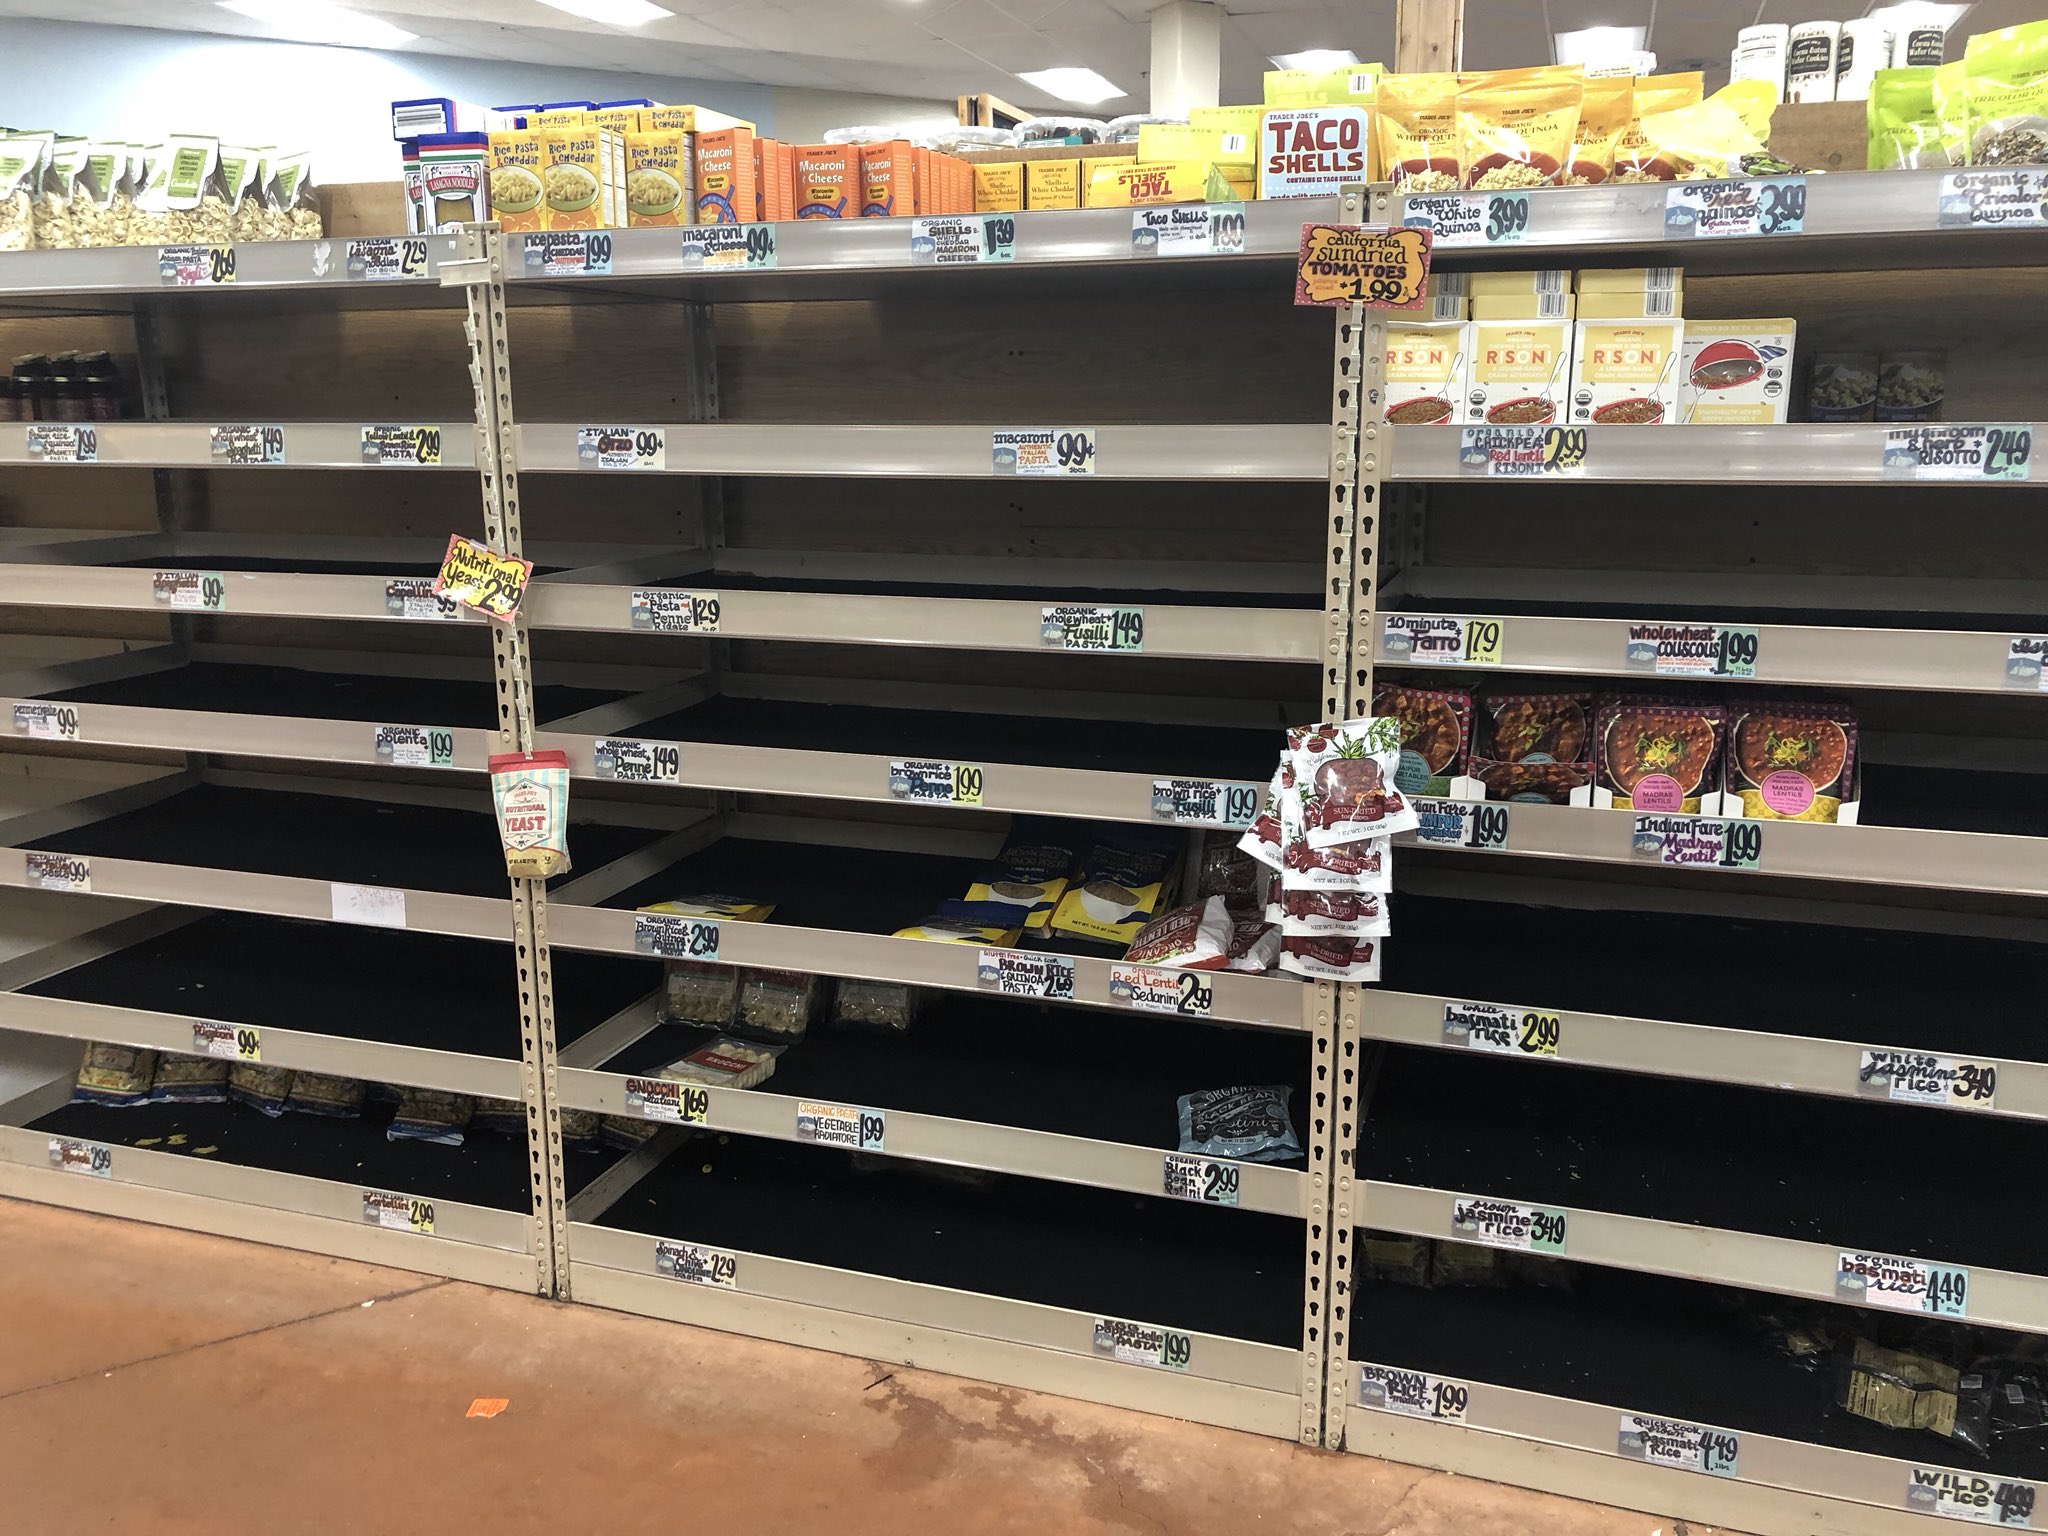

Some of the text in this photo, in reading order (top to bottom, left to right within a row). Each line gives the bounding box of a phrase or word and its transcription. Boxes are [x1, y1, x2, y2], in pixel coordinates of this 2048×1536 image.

[1269, 113, 1295, 121] TRADER
[1268, 118, 1360, 154] TACO
[493, 142, 539, 156] Rice Pasta
[697, 146, 732, 161] Macaroni
[704, 160, 732, 172] Cheese
[799, 160, 845, 172] Macaroni
[1268, 151, 1364, 175] SHELLS
[808, 173, 844, 184] Cheese
[1953, 171, 2030, 190] Organic
[1048, 185, 1075, 193] Cheddar
[1130, 181, 1172, 198] TACO
[1683, 181, 1745, 203] organic
[1707, 187, 1755, 208] red
[1961, 185, 2042, 208] Tricolor
[1408, 198, 1461, 215] Organic
[1434, 207, 1482, 222] White
[1969, 206, 2035, 224] Quinoa
[921, 218, 963, 227] ORGANIC
[1695, 204, 1756, 227] quinoa
[683, 223, 744, 242] macaroni
[928, 226, 972, 237] SHELLS
[1432, 221, 1482, 238] Quinoa
[935, 244, 980, 254] MACARONI
[1326, 233, 1401, 249] california
[365, 257, 399, 268] noodles
[936, 254, 979, 263] CHEESE
[1316, 244, 1410, 265] sundried
[1308, 261, 1408, 279] TOMATOES
[1486, 350, 1552, 364] RISONI
[1593, 349, 1661, 364] RISONI
[217, 426, 251, 434] ORGANIC
[374, 425, 402, 433] organic
[993, 430, 1056, 445] macaroni
[381, 449, 413, 459] PASTA
[1017, 443, 1053, 451] AUTHENTIC
[1489, 448, 1511, 463] Red
[1018, 456, 1051, 465] PASTA
[1917, 449, 1982, 466] RISOTTO
[1495, 462, 1545, 475] RISONI
[453, 545, 519, 586] Nutritional
[392, 580, 431, 588] ITALIAN
[445, 563, 485, 590] Yeast
[642, 591, 685, 604] Organic
[648, 599, 681, 613] Pasta
[650, 611, 691, 625] Penne
[1055, 607, 1098, 616] ORGANIC
[1062, 623, 1110, 641] Fusilli
[1387, 617, 1458, 631] 10 minute
[1065, 640, 1106, 649] PASTA
[1409, 629, 1461, 654] Farro
[1657, 640, 1720, 659] couscous
[382, 727, 421, 736] ORGANIC
[605, 740, 641, 749] ORGANIC
[614, 755, 652, 774] Penne
[903, 761, 943, 770] ORGANIC
[616, 772, 649, 781] PASTA
[909, 777, 953, 795] Penne
[1153, 784, 1217, 802] brown rice
[1171, 780, 1215, 791] ORGANIC
[1772, 785, 1804, 793] MADRAS
[913, 791, 950, 799] PASTA
[505, 803, 547, 814] NUTRITIONAL
[1176, 810, 1217, 820] PASTA
[1436, 801, 1468, 818] Fare
[505, 814, 547, 833] YEAST
[1419, 813, 1464, 830] JAIPUR
[1660, 833, 1724, 852] Madras
[1663, 848, 1719, 864] Lentil
[41, 867, 70, 883] pasta
[645, 916, 682, 927] ORGANIC
[998, 957, 1074, 979] BROWN RICE
[1132, 966, 1163, 980] Organic
[1002, 979, 1039, 995] PASTA
[1005, 970, 1045, 987] QUINOA
[1113, 970, 1181, 990] Red Lentil
[1132, 985, 1179, 1005] Sedanini
[1462, 1003, 1508, 1016] white
[1445, 1006, 1518, 1032] basmati
[1869, 1051, 1938, 1068] white
[1860, 1061, 1960, 1082] jasmine
[625, 1078, 681, 1101] GNOCCHI
[1894, 1077, 1942, 1093] rice
[799, 1102, 835, 1117] ORGANIC
[813, 1115, 860, 1135] VEGETABLE
[814, 1129, 858, 1146] RADIATORE
[1165, 1161, 1202, 1178] Black
[1168, 1156, 1202, 1168] ORGANIC
[1454, 1203, 1532, 1228] jasmine
[1485, 1221, 1525, 1238] rice
[655, 1240, 689, 1259] Spinach
[1854, 1253, 1915, 1270] organic
[674, 1272, 703, 1283] pasta
[1841, 1256, 1928, 1286] basmati
[1867, 1278, 1928, 1295] rice
[1116, 1335, 1158, 1353] PASTA
[1362, 1365, 1428, 1389] BROWN
[1385, 1380, 1429, 1400] RICE
[1638, 1430, 1700, 1452] Basmati
[1649, 1442, 1682, 1459] Rice
[1912, 1468, 1990, 1495] WILD
[1937, 1488, 1990, 1509] rice
